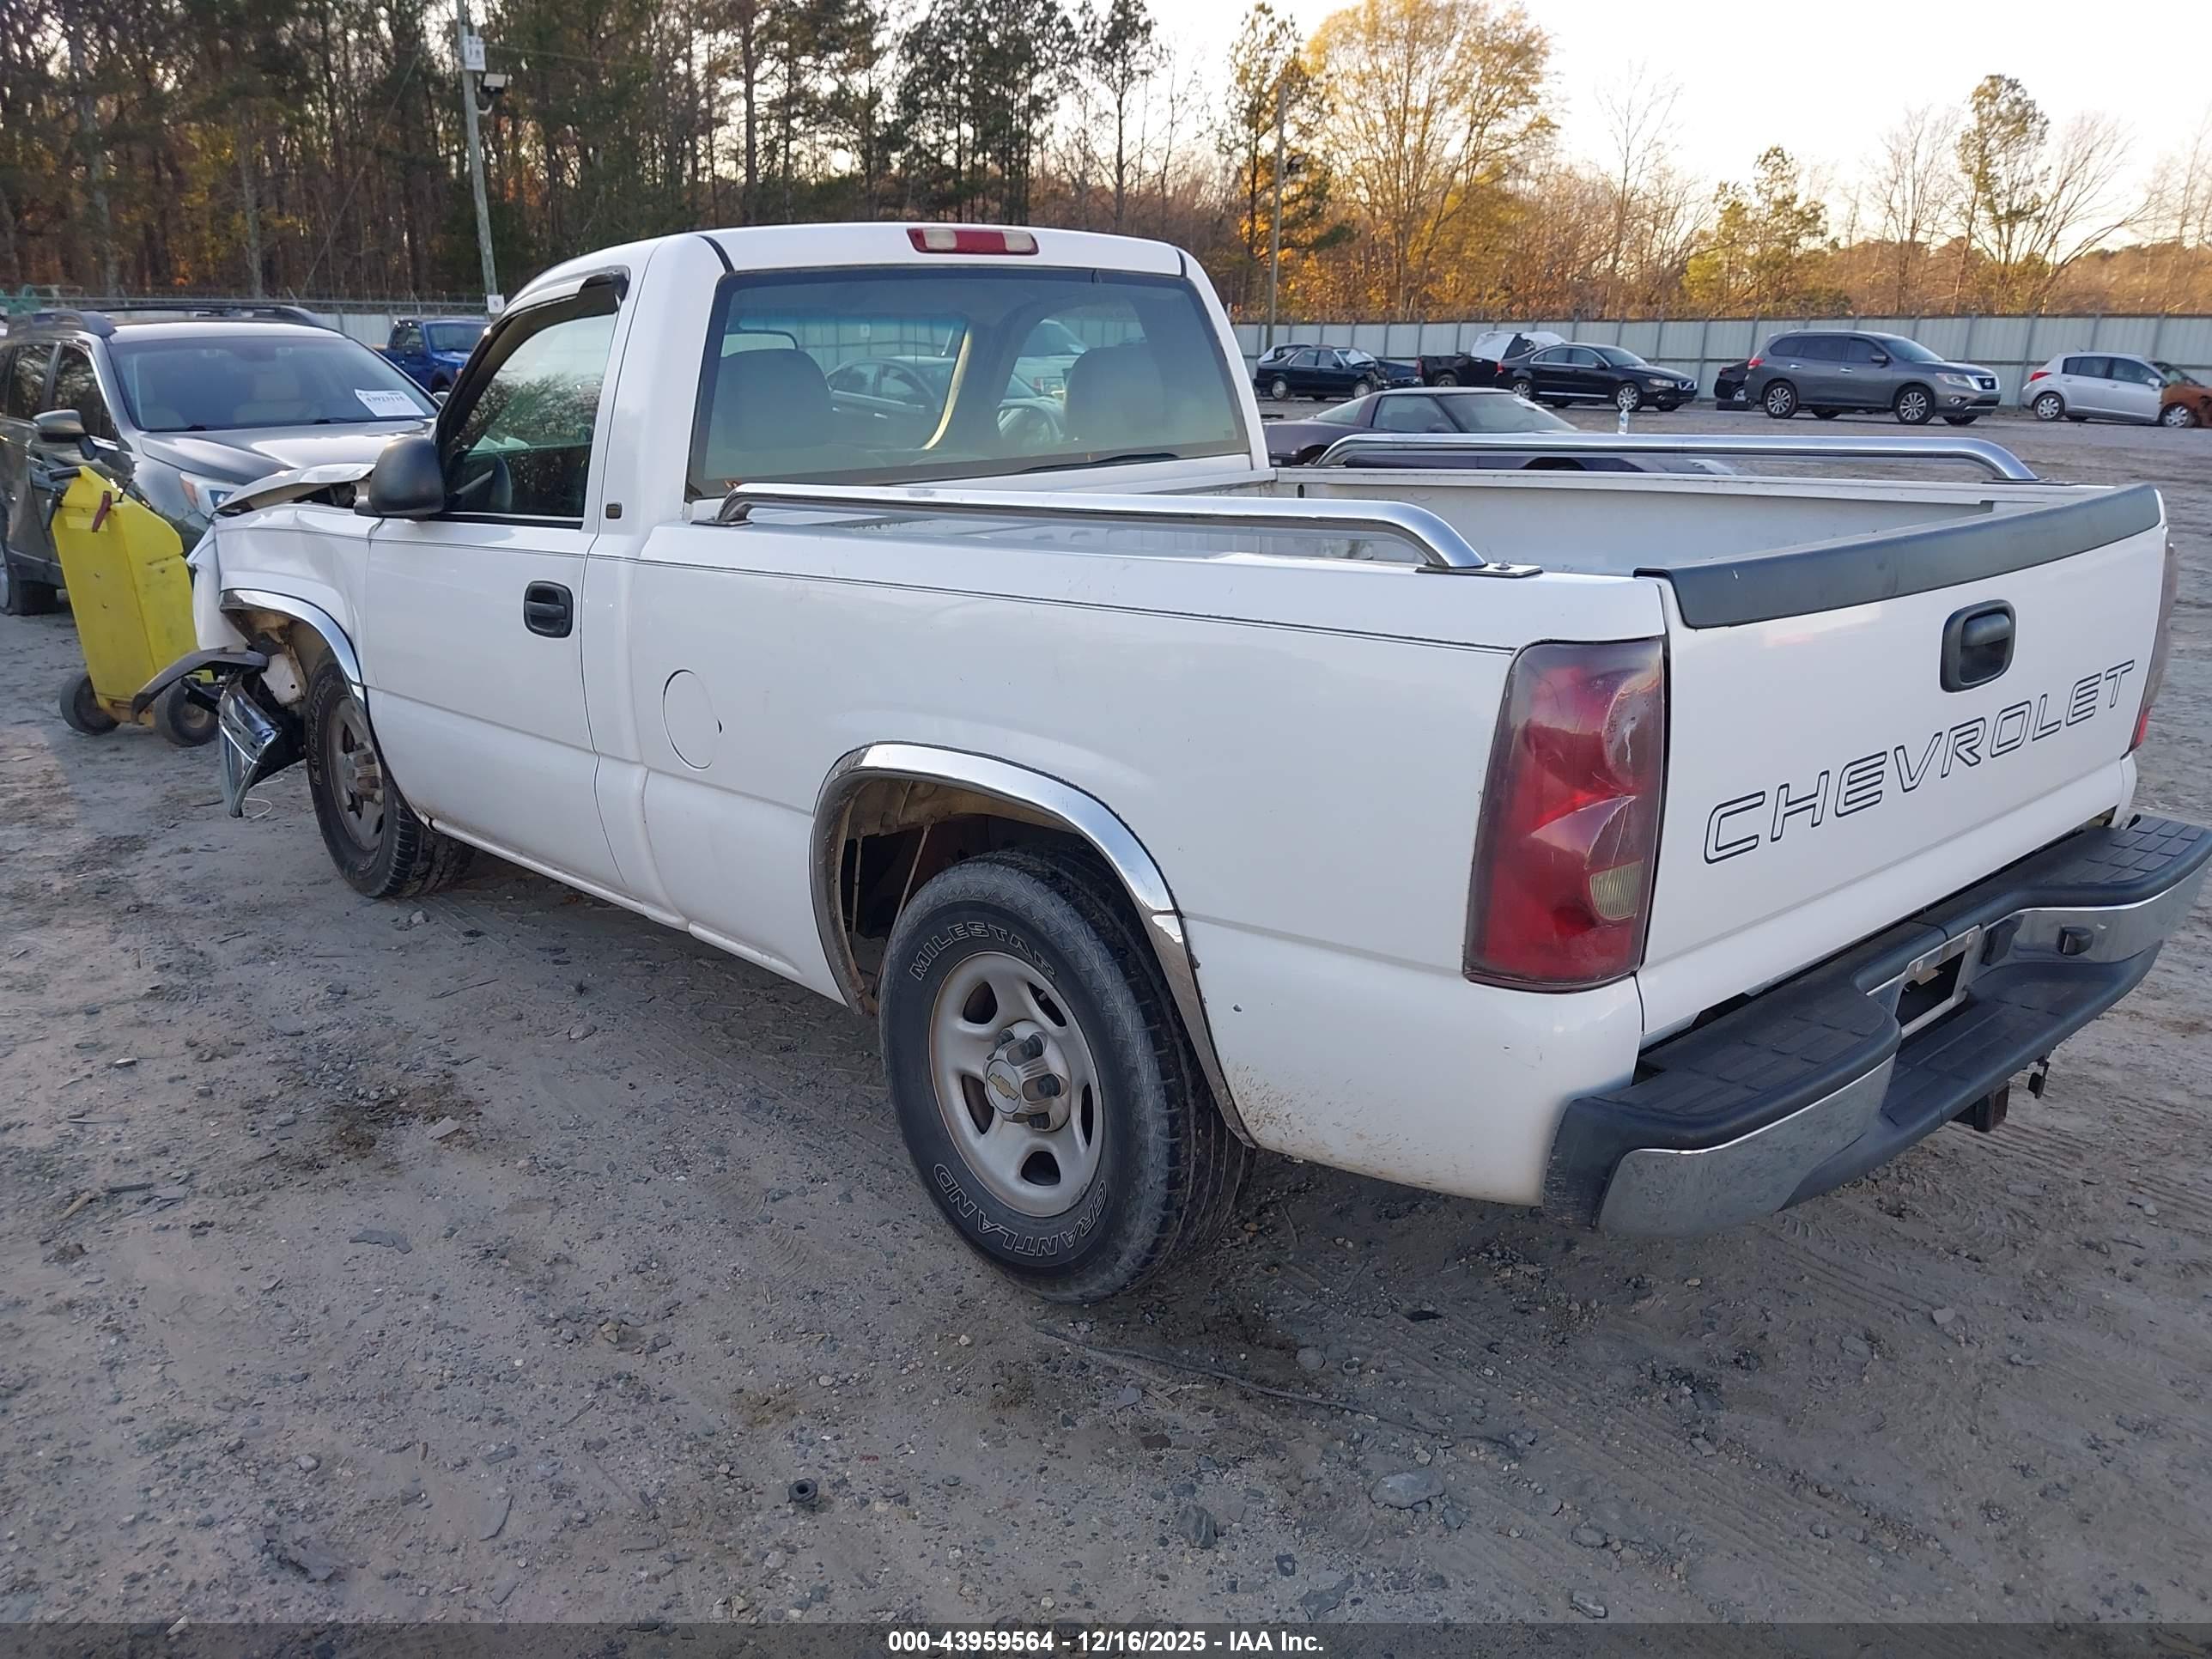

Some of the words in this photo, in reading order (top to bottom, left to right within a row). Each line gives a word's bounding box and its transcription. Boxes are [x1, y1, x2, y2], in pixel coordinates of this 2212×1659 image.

[1704, 659, 2135, 864] CHEVROLET
[909, 922, 1056, 982] MILESTAR
[934, 1164, 1107, 1256] GRANTLAND
